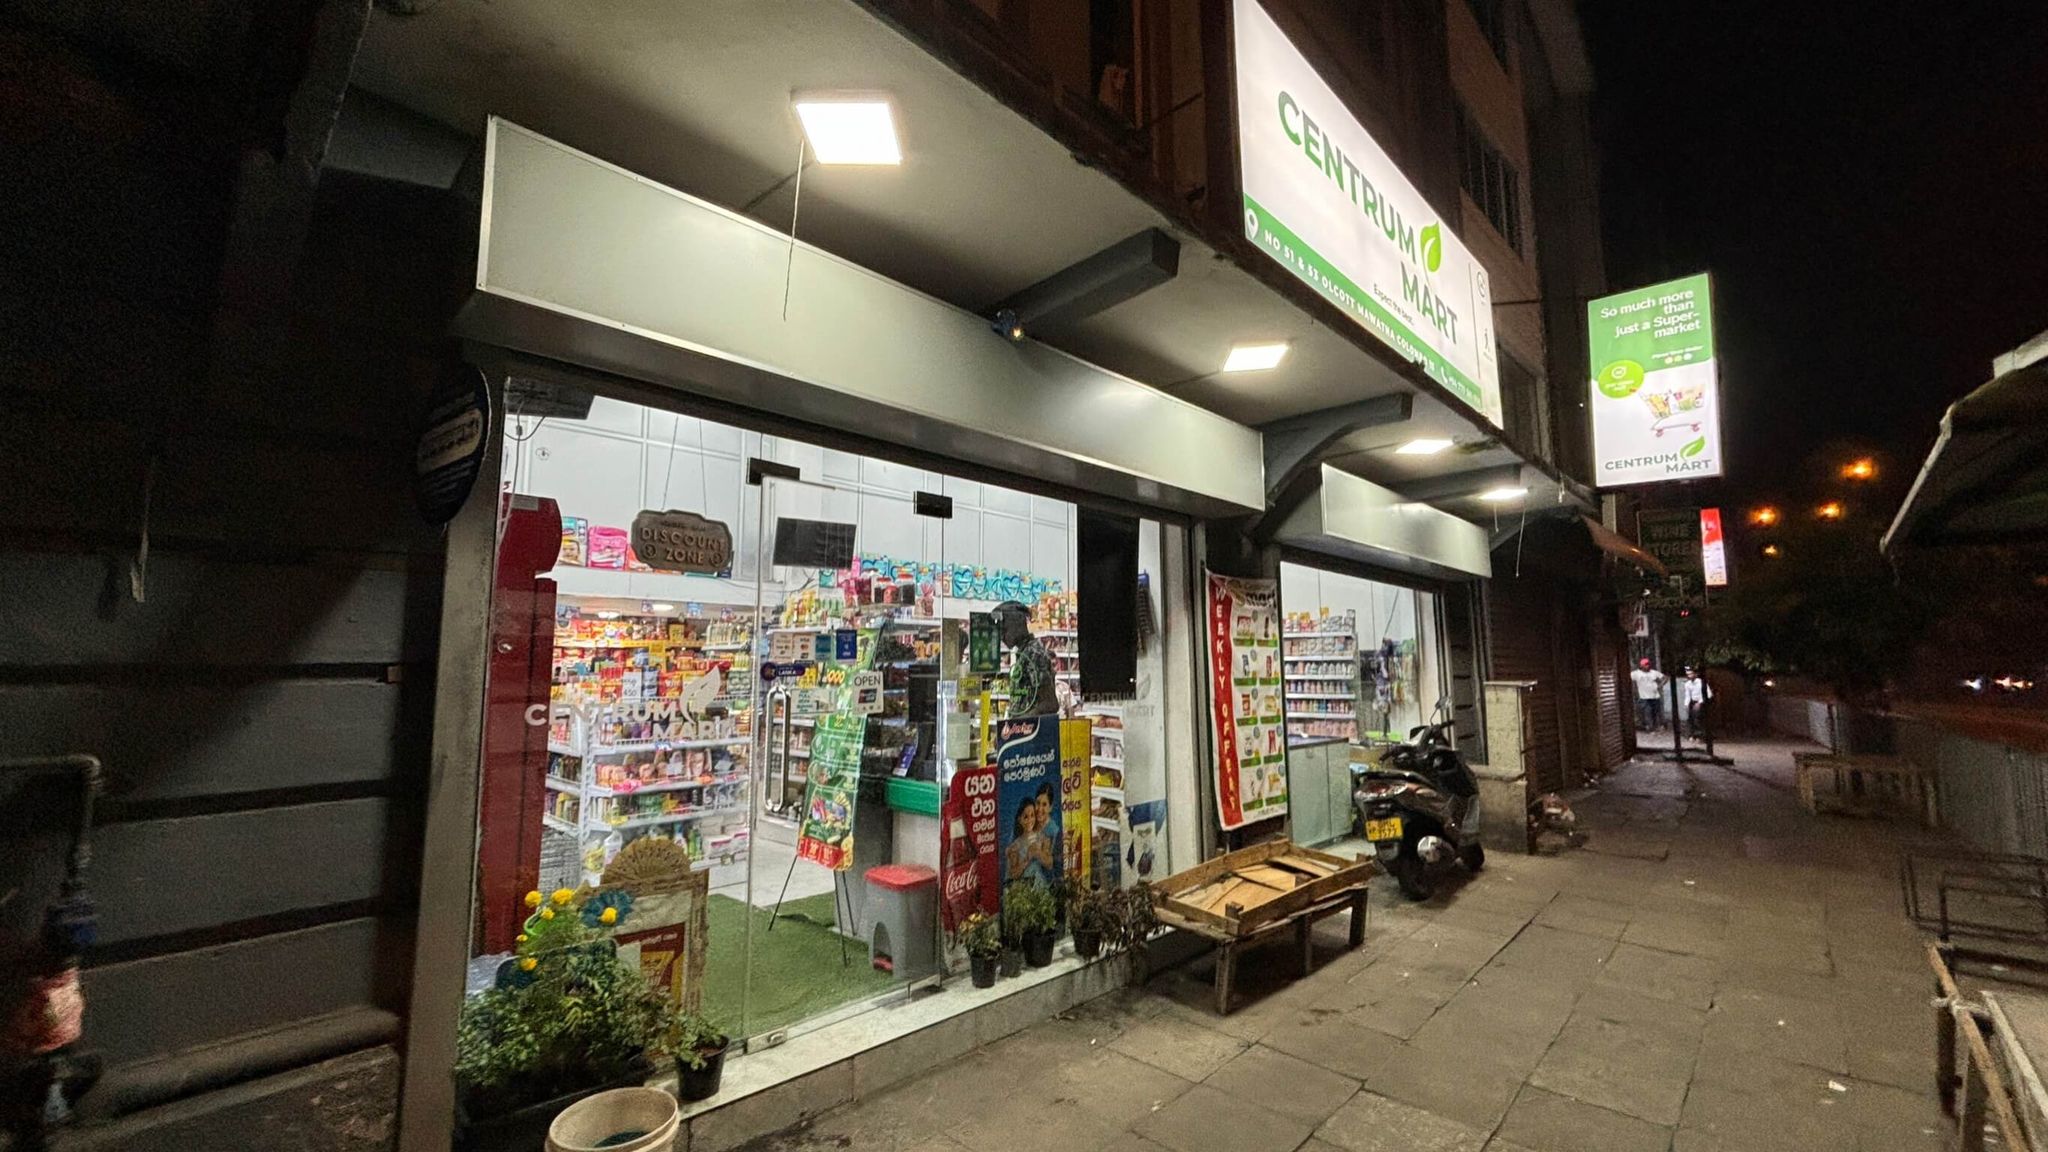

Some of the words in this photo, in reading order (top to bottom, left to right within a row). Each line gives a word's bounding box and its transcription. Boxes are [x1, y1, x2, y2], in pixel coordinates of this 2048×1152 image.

[1277, 90, 1417, 265] CENTRUM
[1264, 230, 1280, 250] NO
[1284, 245, 1295, 263] 51
[1297, 257, 1305, 271] &
[1322, 275, 1356, 310] OLCOTT
[1357, 301, 1395, 342] MAWATHA
[1396, 334, 1429, 370] COLOMBO
[1400, 260, 1458, 345] MART
[1600, 306, 1618, 319] So
[1619, 298, 1656, 315] much
[1659, 289, 1695, 305] more
[1663, 300, 1695, 315] than
[1614, 322, 1640, 338] just
[1641, 320, 1651, 331] a
[1653, 311, 1700, 328] Super-
[1654, 319, 1701, 338] market
[1604, 451, 1678, 471] CENTRUM
[1665, 458, 1713, 474] MART
[640, 527, 725, 551] DISCOUNT
[665, 547, 706, 566] ZONE
[1214, 586, 1228, 690] WEEKLY
[854, 675, 882, 687] OPEN
[964, 773, 996, 797] යන
